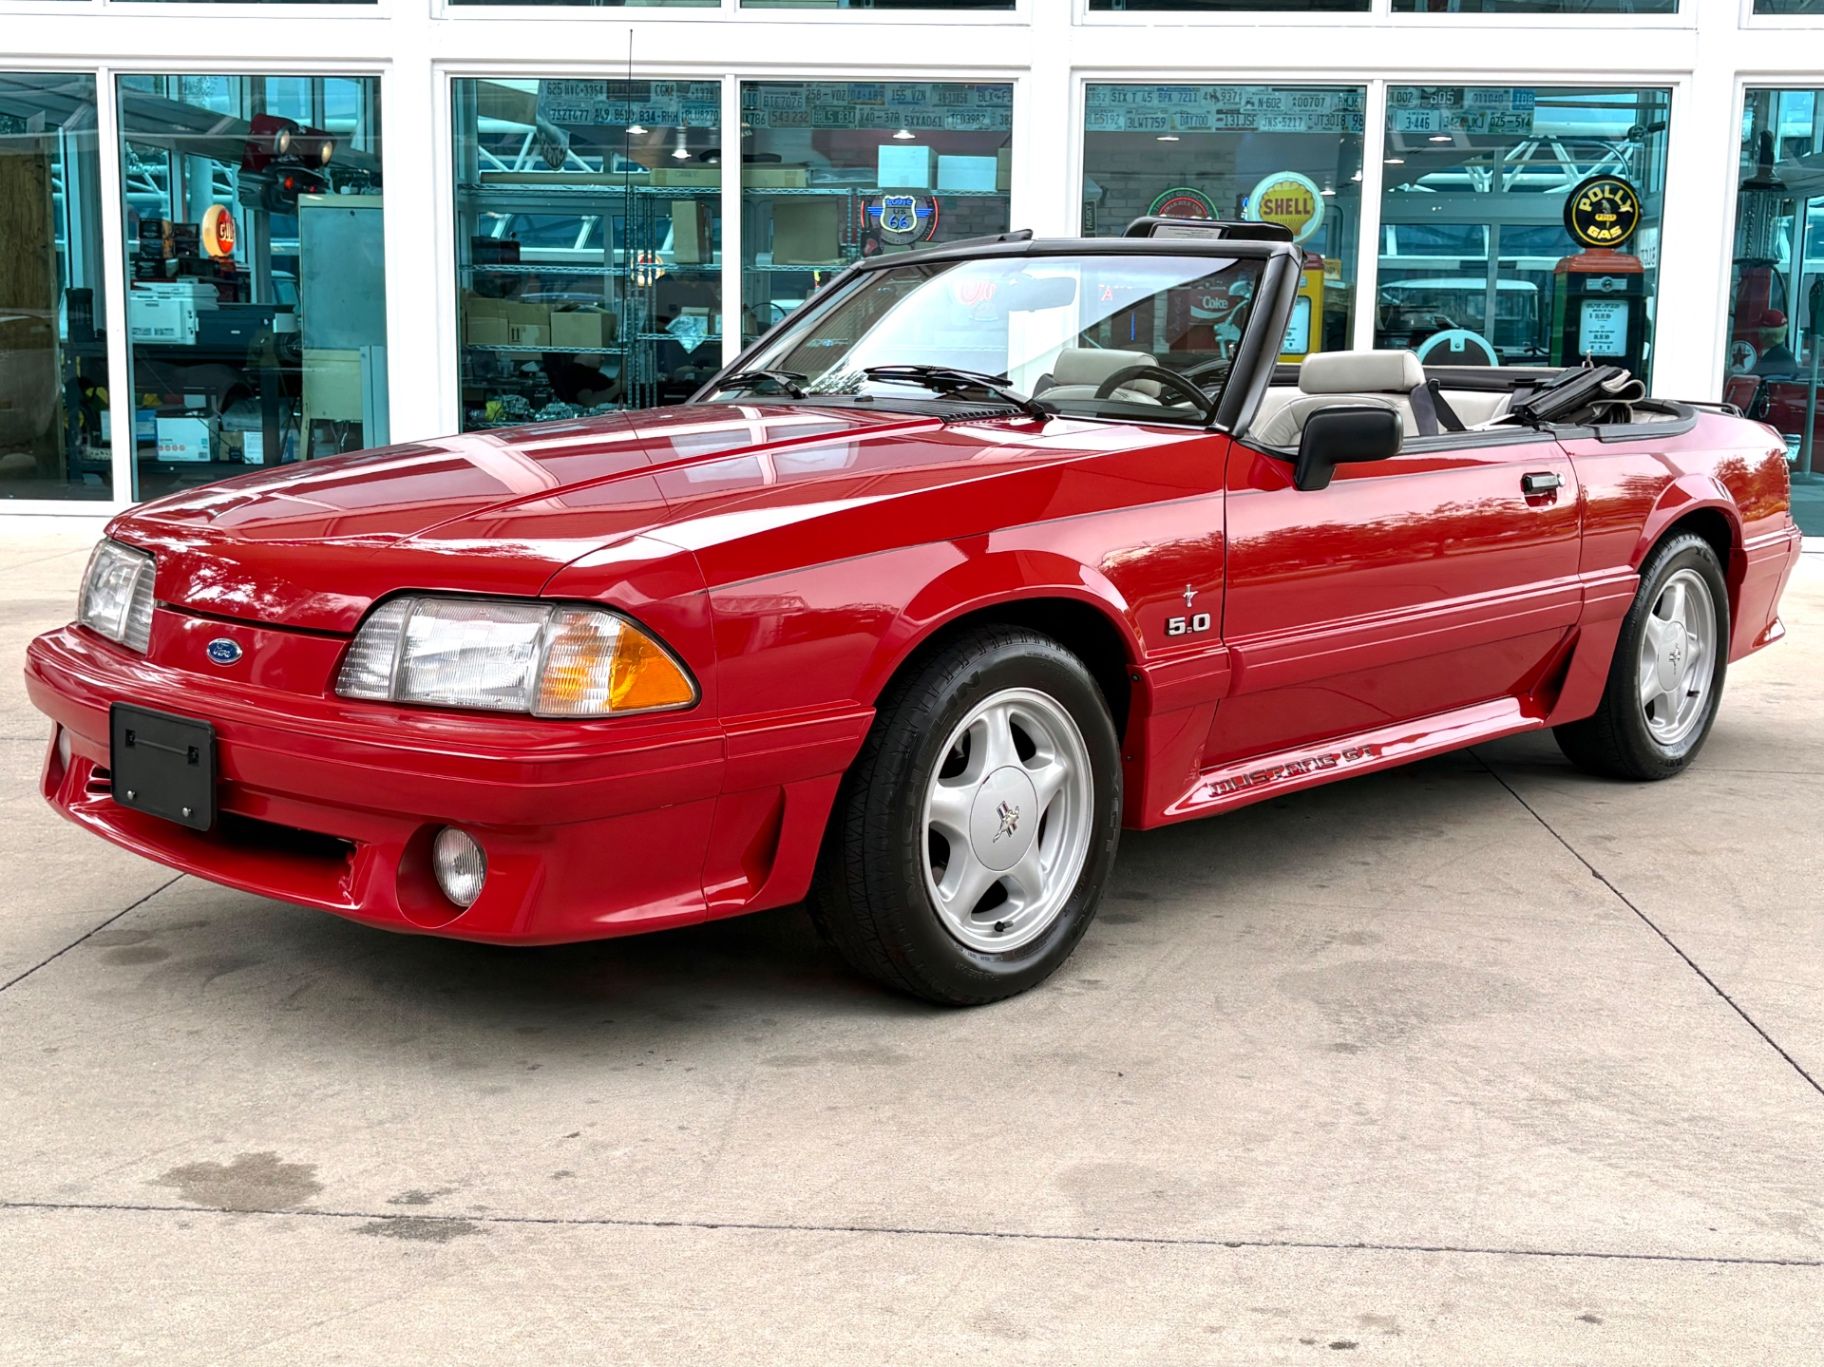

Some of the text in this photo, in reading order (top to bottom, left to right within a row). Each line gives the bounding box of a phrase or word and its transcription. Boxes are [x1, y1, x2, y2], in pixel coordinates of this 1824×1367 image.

[1263, 198, 1311, 216] SHELL
[1578, 185, 1634, 214] POLLY
[888, 214, 909, 229] 66
[220, 223, 234, 242] GUL
[1586, 225, 1623, 240] GAS
[1167, 612, 1211, 636] 5.0
[1208, 744, 1376, 798] MUSTANG GT
